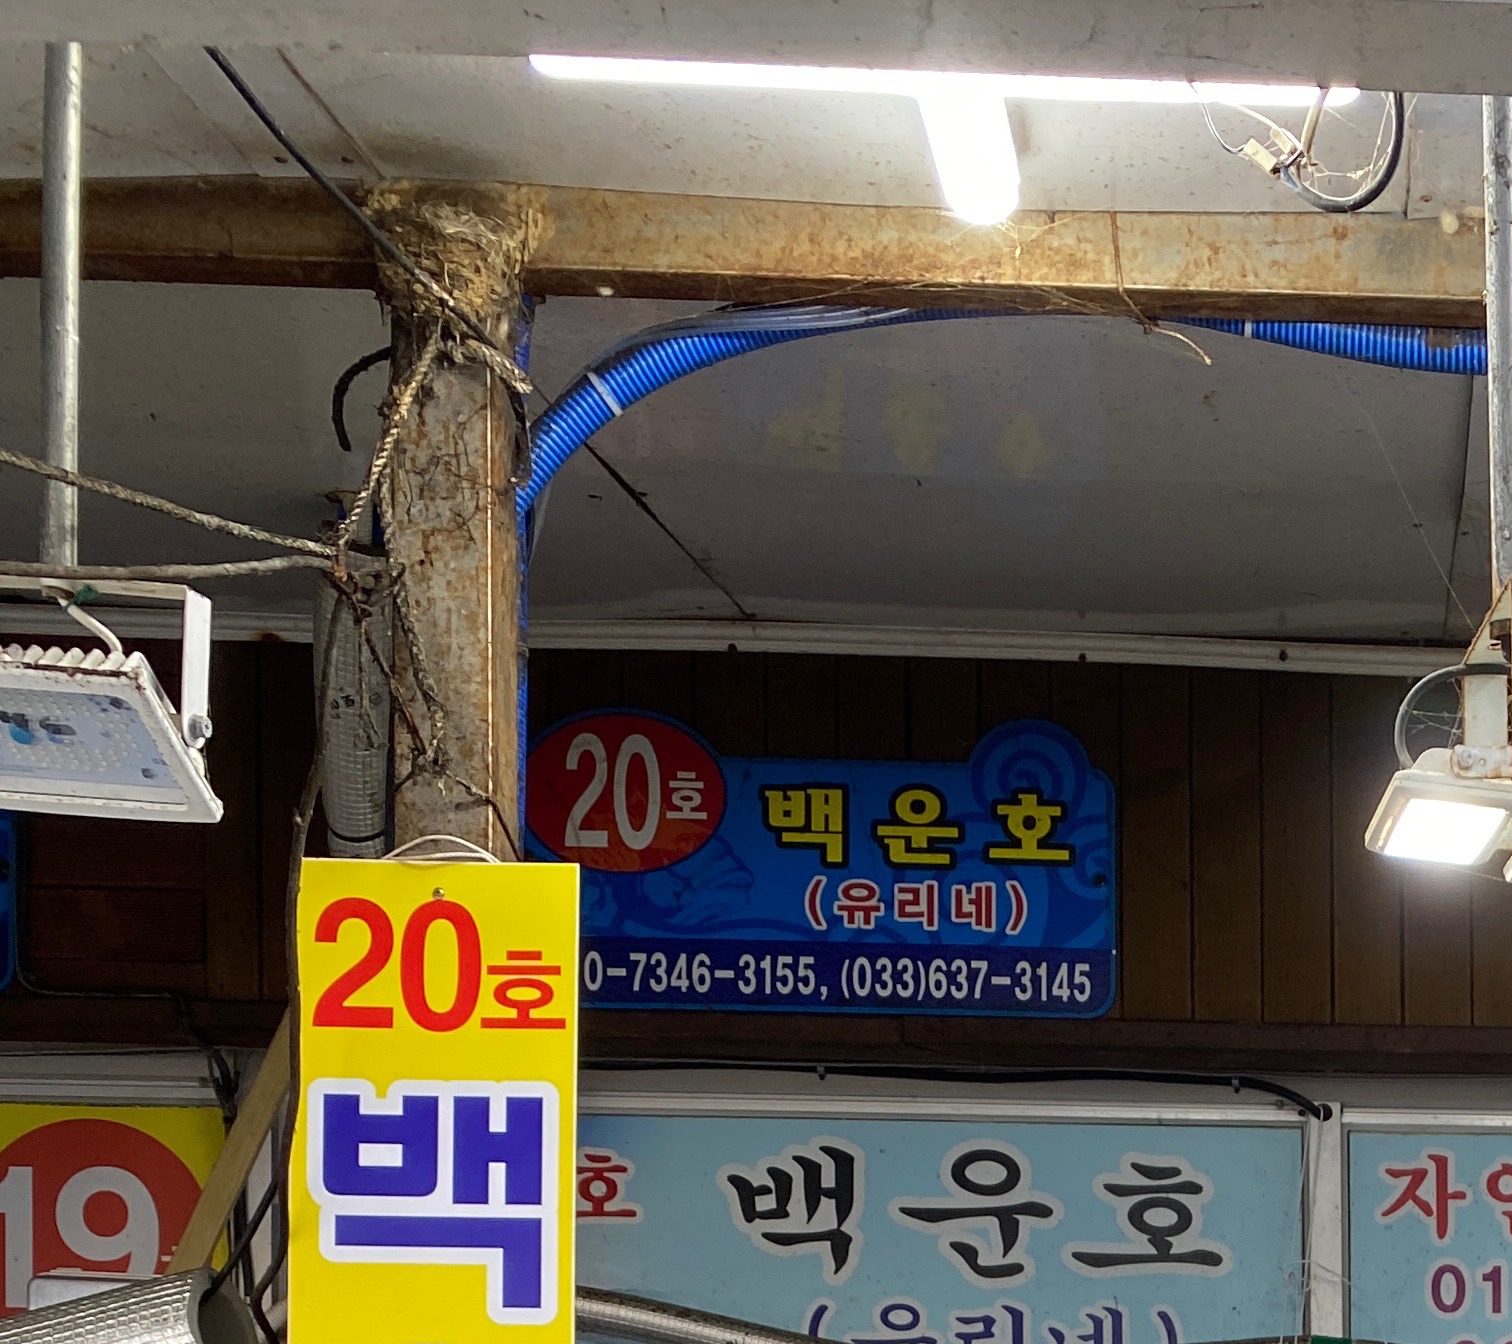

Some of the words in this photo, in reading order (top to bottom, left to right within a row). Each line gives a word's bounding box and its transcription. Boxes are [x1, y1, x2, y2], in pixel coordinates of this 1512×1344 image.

[565, 732, 708, 850] 20호
[763, 785, 1072, 866] 백운호
[805, 876, 1028, 934] (유리네)
[312, 897, 567, 1032] 20호
[841, 956, 1092, 1003] (033)637-3145
[0, 1166, 178, 1308] 19
[727, 1145, 1223, 1279] 백운호
